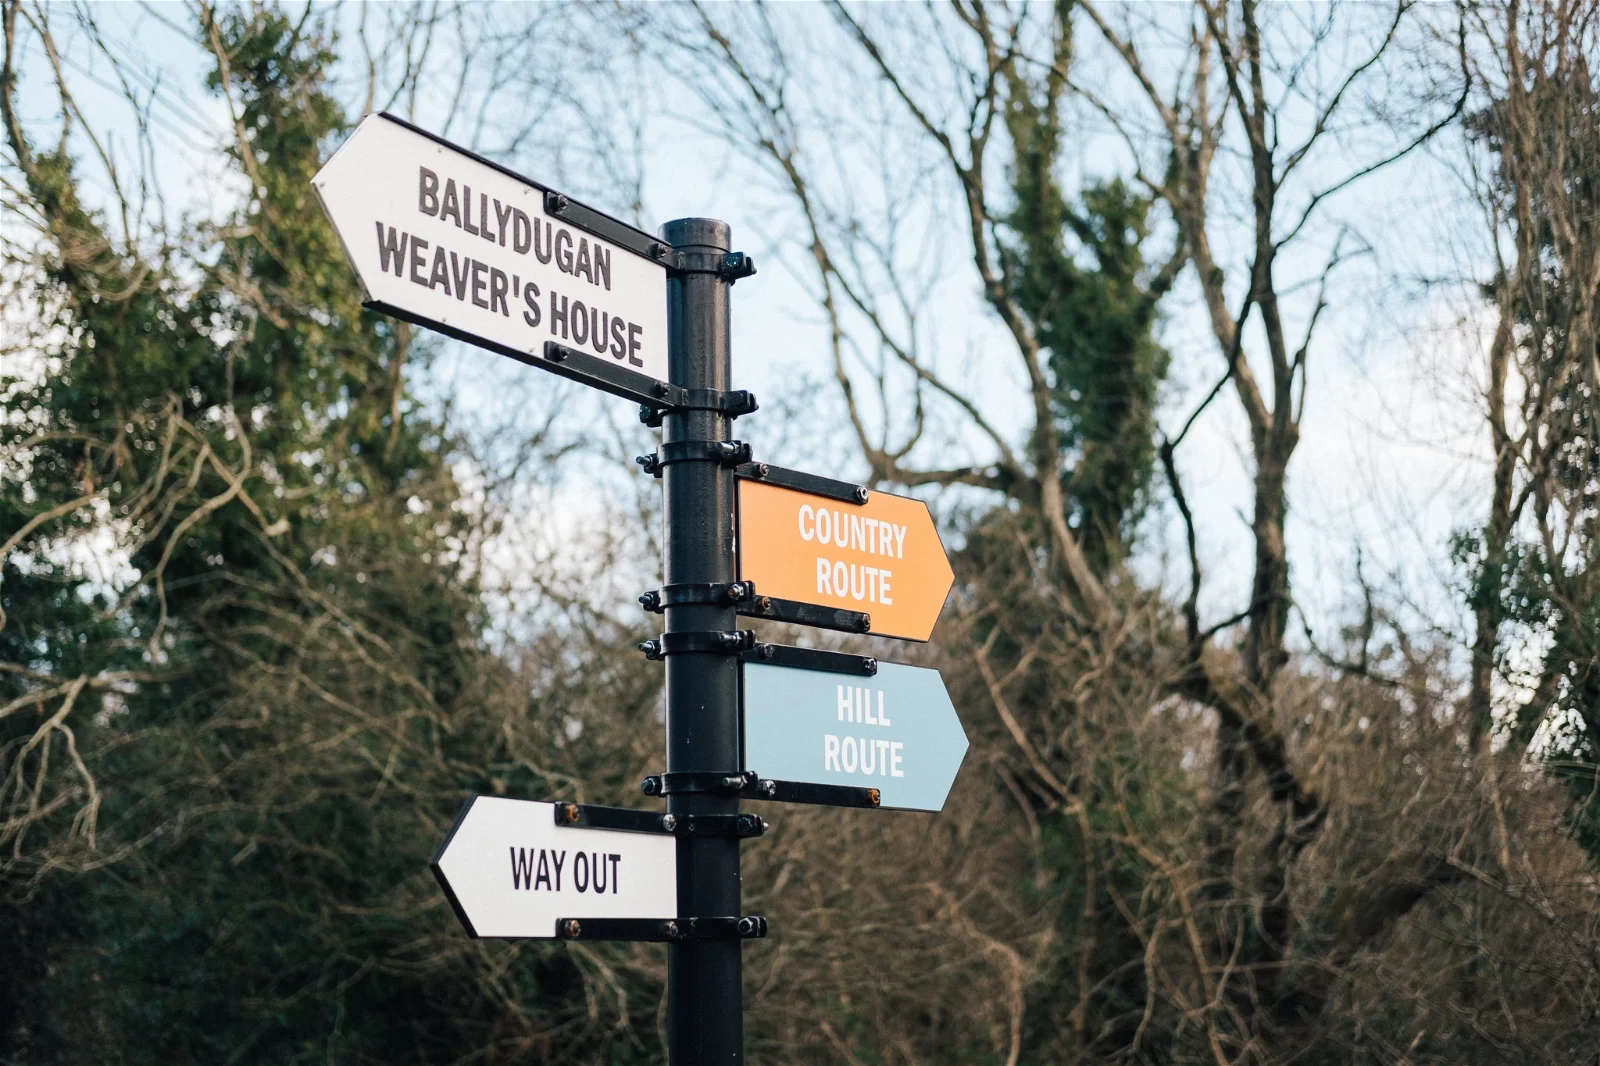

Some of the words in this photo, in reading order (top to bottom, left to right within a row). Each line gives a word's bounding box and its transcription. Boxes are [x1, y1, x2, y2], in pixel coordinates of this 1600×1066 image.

[419, 166, 611, 290] BALLYDUGAN
[375, 221, 541, 327] WEAVER'S
[550, 291, 643, 367] HOUSE
[798, 504, 907, 559] COUNTRY
[816, 558, 892, 605] ROUTE
[837, 685, 891, 726] HILL
[824, 734, 904, 777] ROUTE
[510, 847, 566, 891] WAY
[573, 851, 621, 894] OUT
